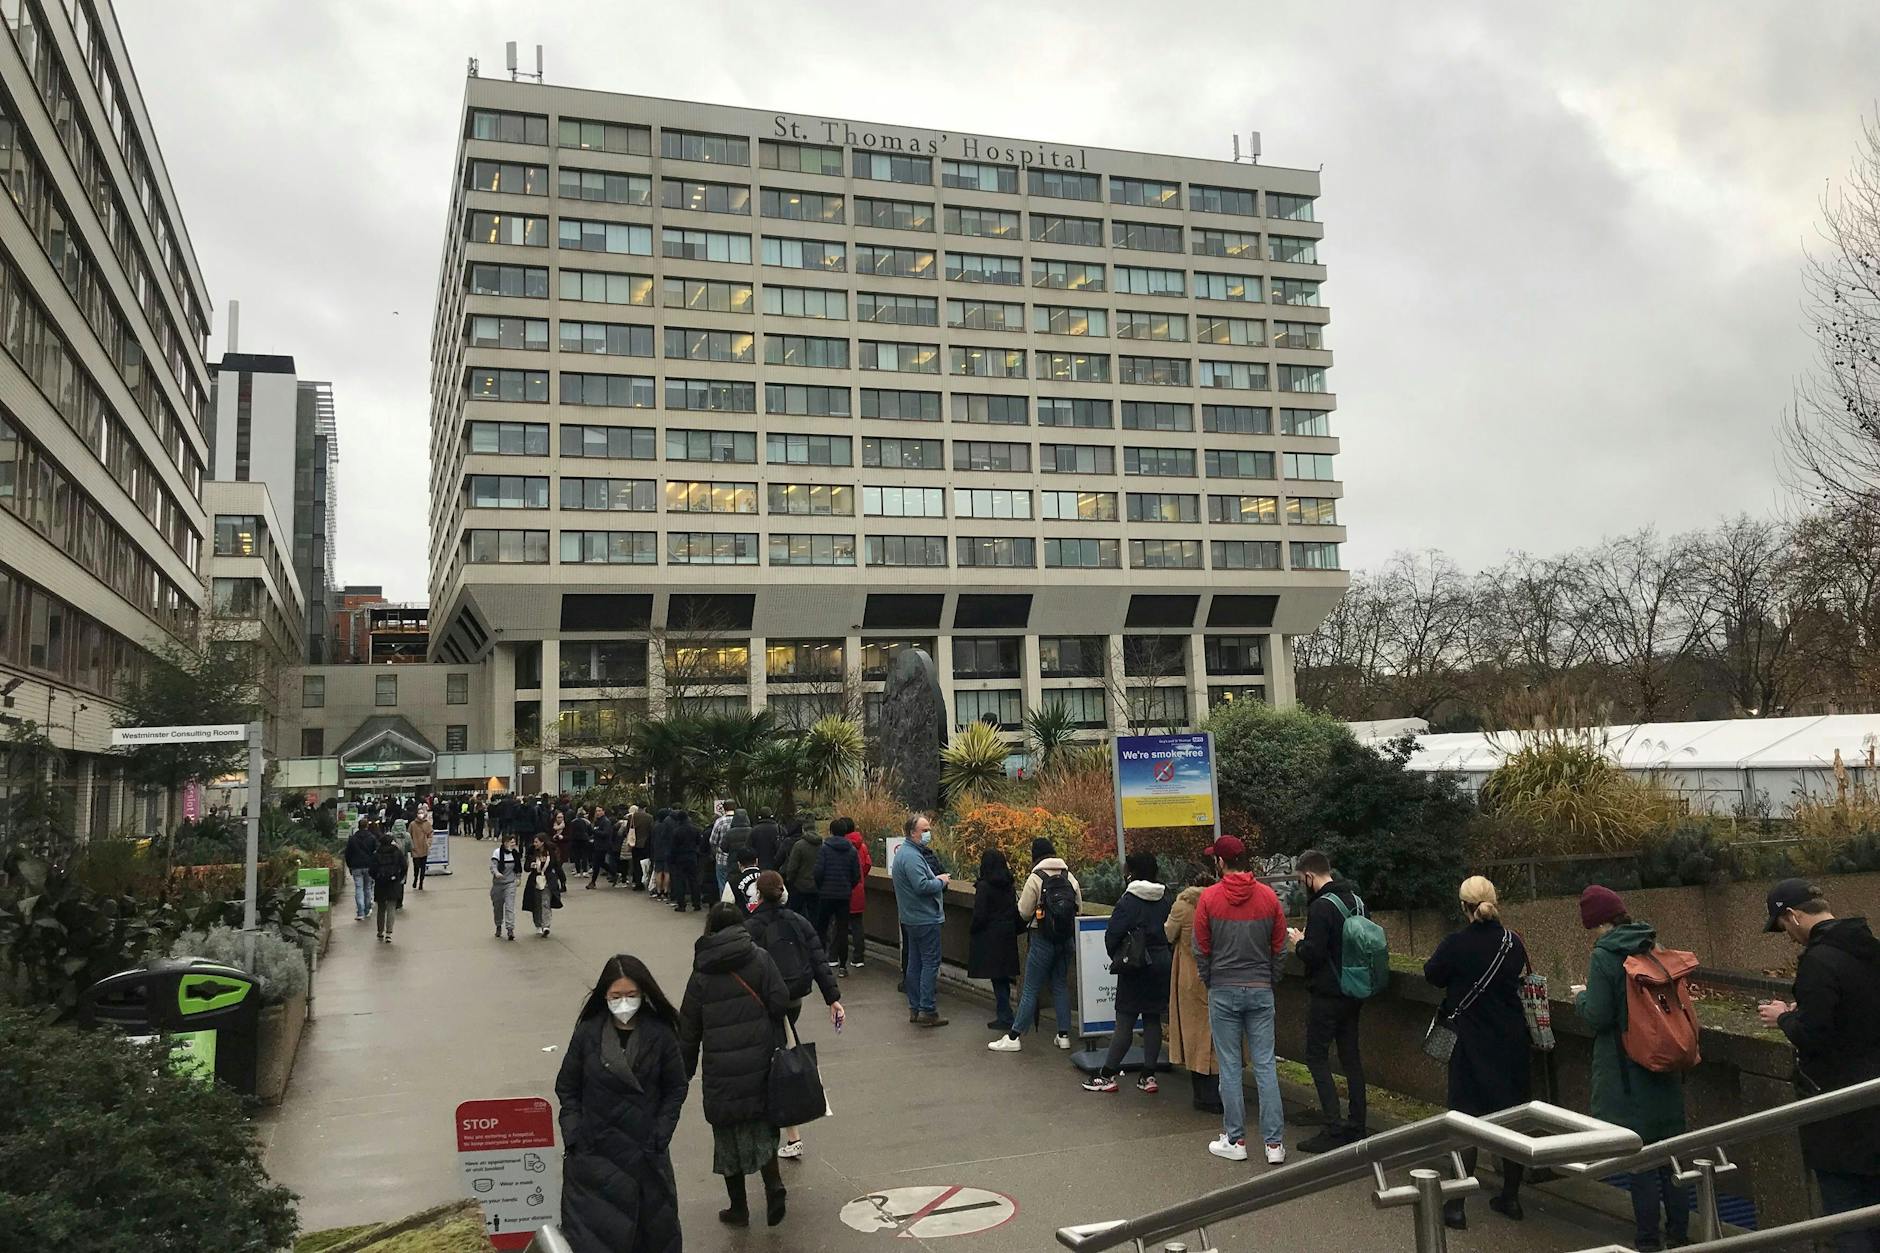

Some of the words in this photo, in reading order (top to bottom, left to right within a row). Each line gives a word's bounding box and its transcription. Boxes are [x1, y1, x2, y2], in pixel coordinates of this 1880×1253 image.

[774, 115, 808, 140] St.
[964, 138, 1087, 170] Hospital
[122, 731, 169, 739] Westminster
[171, 730, 211, 738] Consulting
[1122, 750, 1149, 760] We're
[738, 874, 754, 890] SPORT
[463, 1118, 499, 1130] STOP
